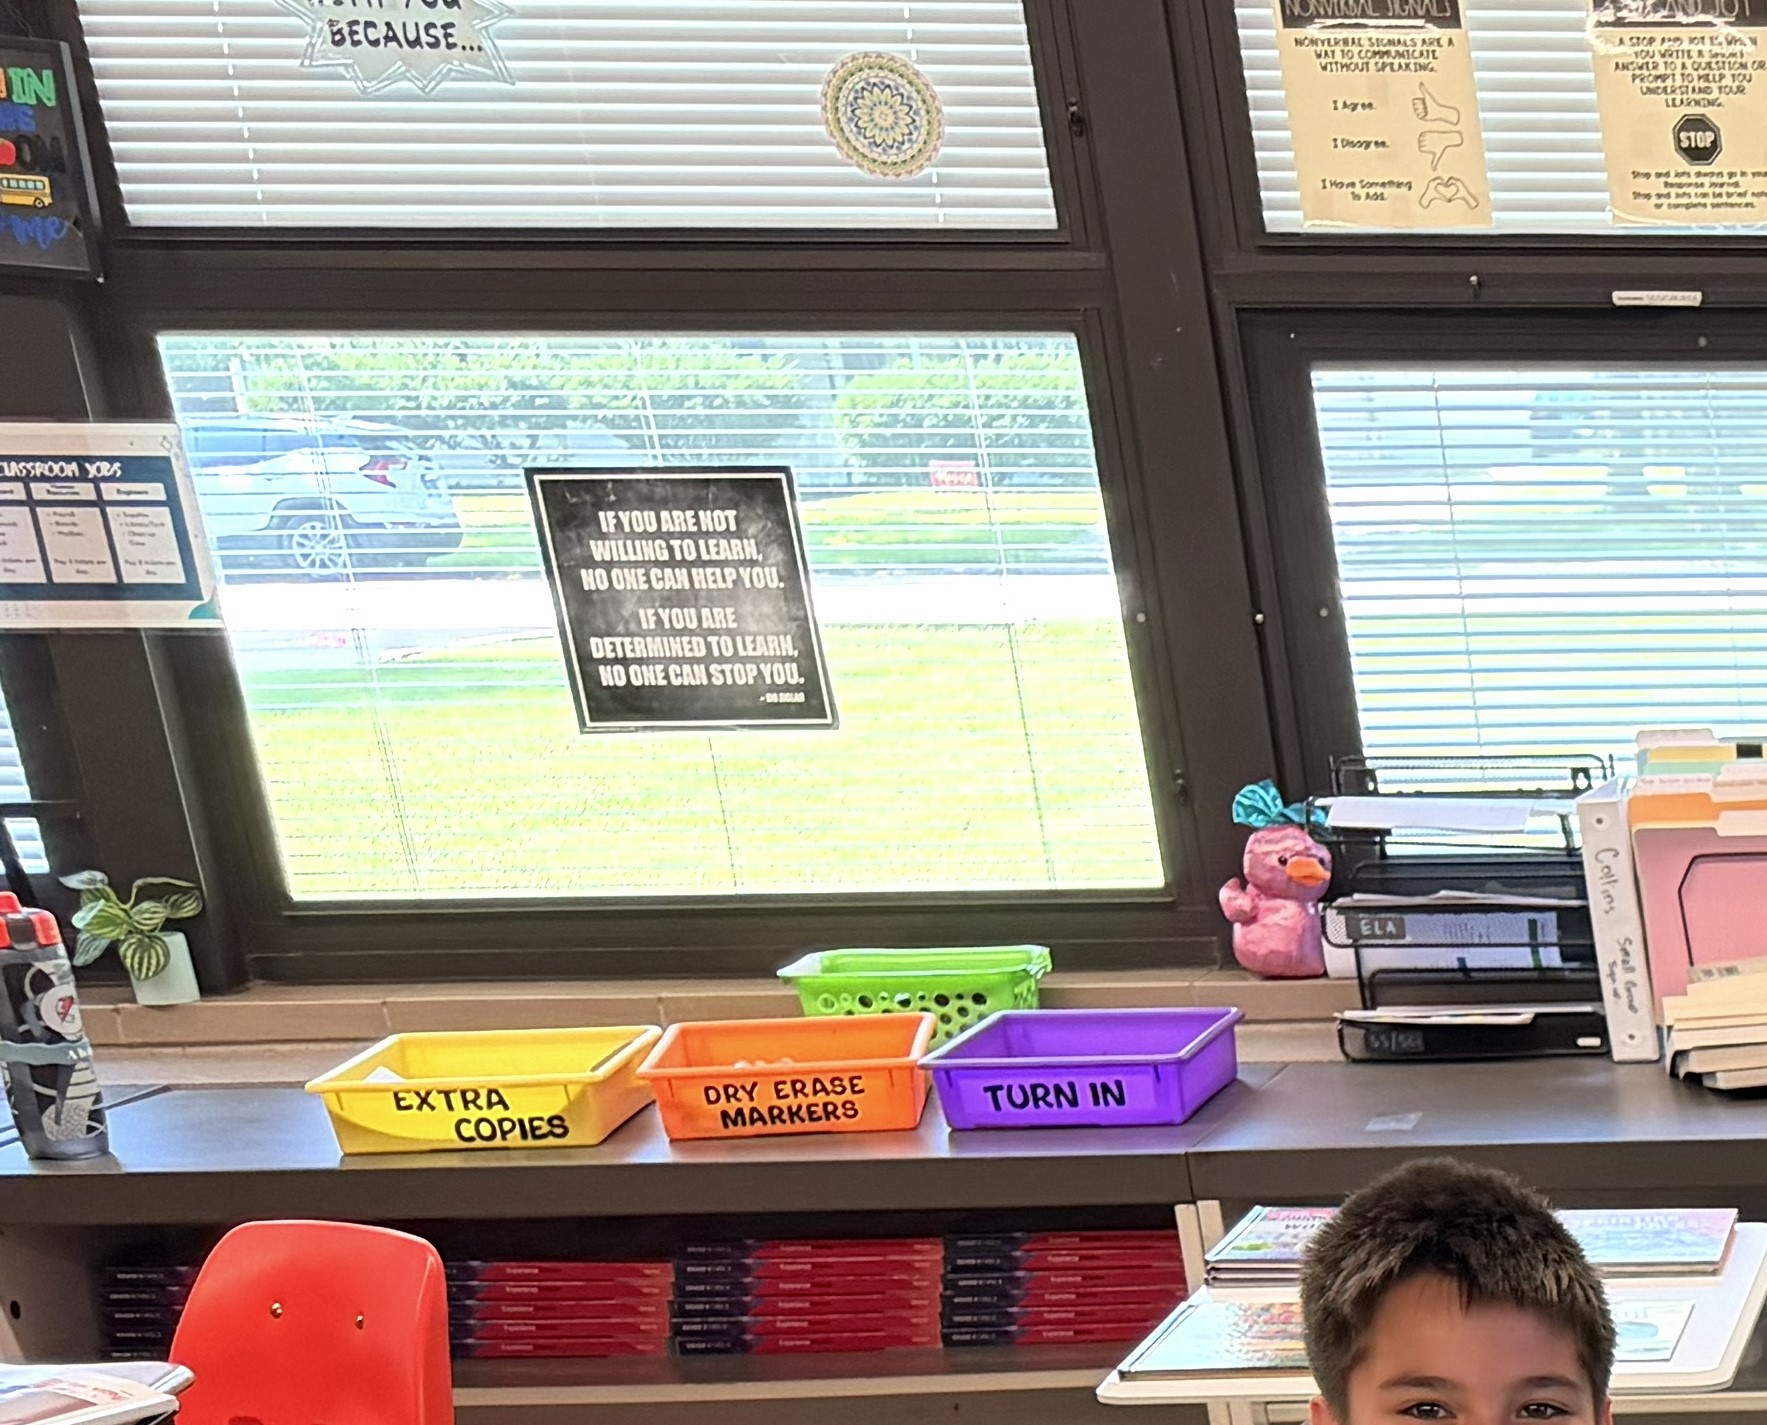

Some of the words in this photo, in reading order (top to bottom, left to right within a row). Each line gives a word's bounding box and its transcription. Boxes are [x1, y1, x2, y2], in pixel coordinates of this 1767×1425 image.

[1294, 37, 1364, 48] NONVERBAL
[1368, 37, 1417, 48] SIGNALS
[1421, 37, 1443, 48] ARE
[1448, 37, 1455, 47] A
[1340, 50, 1354, 60] TO
[1663, 61, 1677, 71] TO
[1681, 61, 1688, 71] A
[1691, 61, 1748, 72] QUESTION
[1679, 131, 1715, 148] STOP
[599, 511, 616, 533] IF
[618, 511, 657, 533] YOU
[661, 511, 698, 532] ARE
[699, 510, 737, 532] NOT
[590, 539, 669, 561] WILLING
[670, 539, 697, 561] TO
[700, 539, 763, 562] LEARN,
[581, 568, 608, 590] NO
[611, 568, 649, 590] ONE
[652, 568, 690, 590] CAN
[691, 568, 737, 589] HELP
[739, 567, 784, 589] YOU.
[639, 608, 656, 630] IF
[659, 608, 698, 630] YOU
[701, 607, 737, 629] ARE
[590, 636, 706, 659] DETERMINED
[708, 636, 734, 658] TO
[735, 635, 798, 658] LEARN,
[599, 664, 626, 687] NO
[629, 664, 666, 686] ONE
[668, 664, 708, 686] CAN
[710, 663, 757, 685] STOP
[759, 663, 804, 685] YOU.
[1595, 848, 1620, 915] Collins
[1360, 920, 1397, 934] ELA
[393, 1088, 510, 1112] EXTRA
[704, 1080, 758, 1105] DRY
[773, 1075, 866, 1100] ERASE
[984, 1081, 1079, 1112] TURN
[1089, 1080, 1126, 1107] IN
[720, 1100, 859, 1129] MARKERS
[455, 1113, 570, 1142] COPIES
